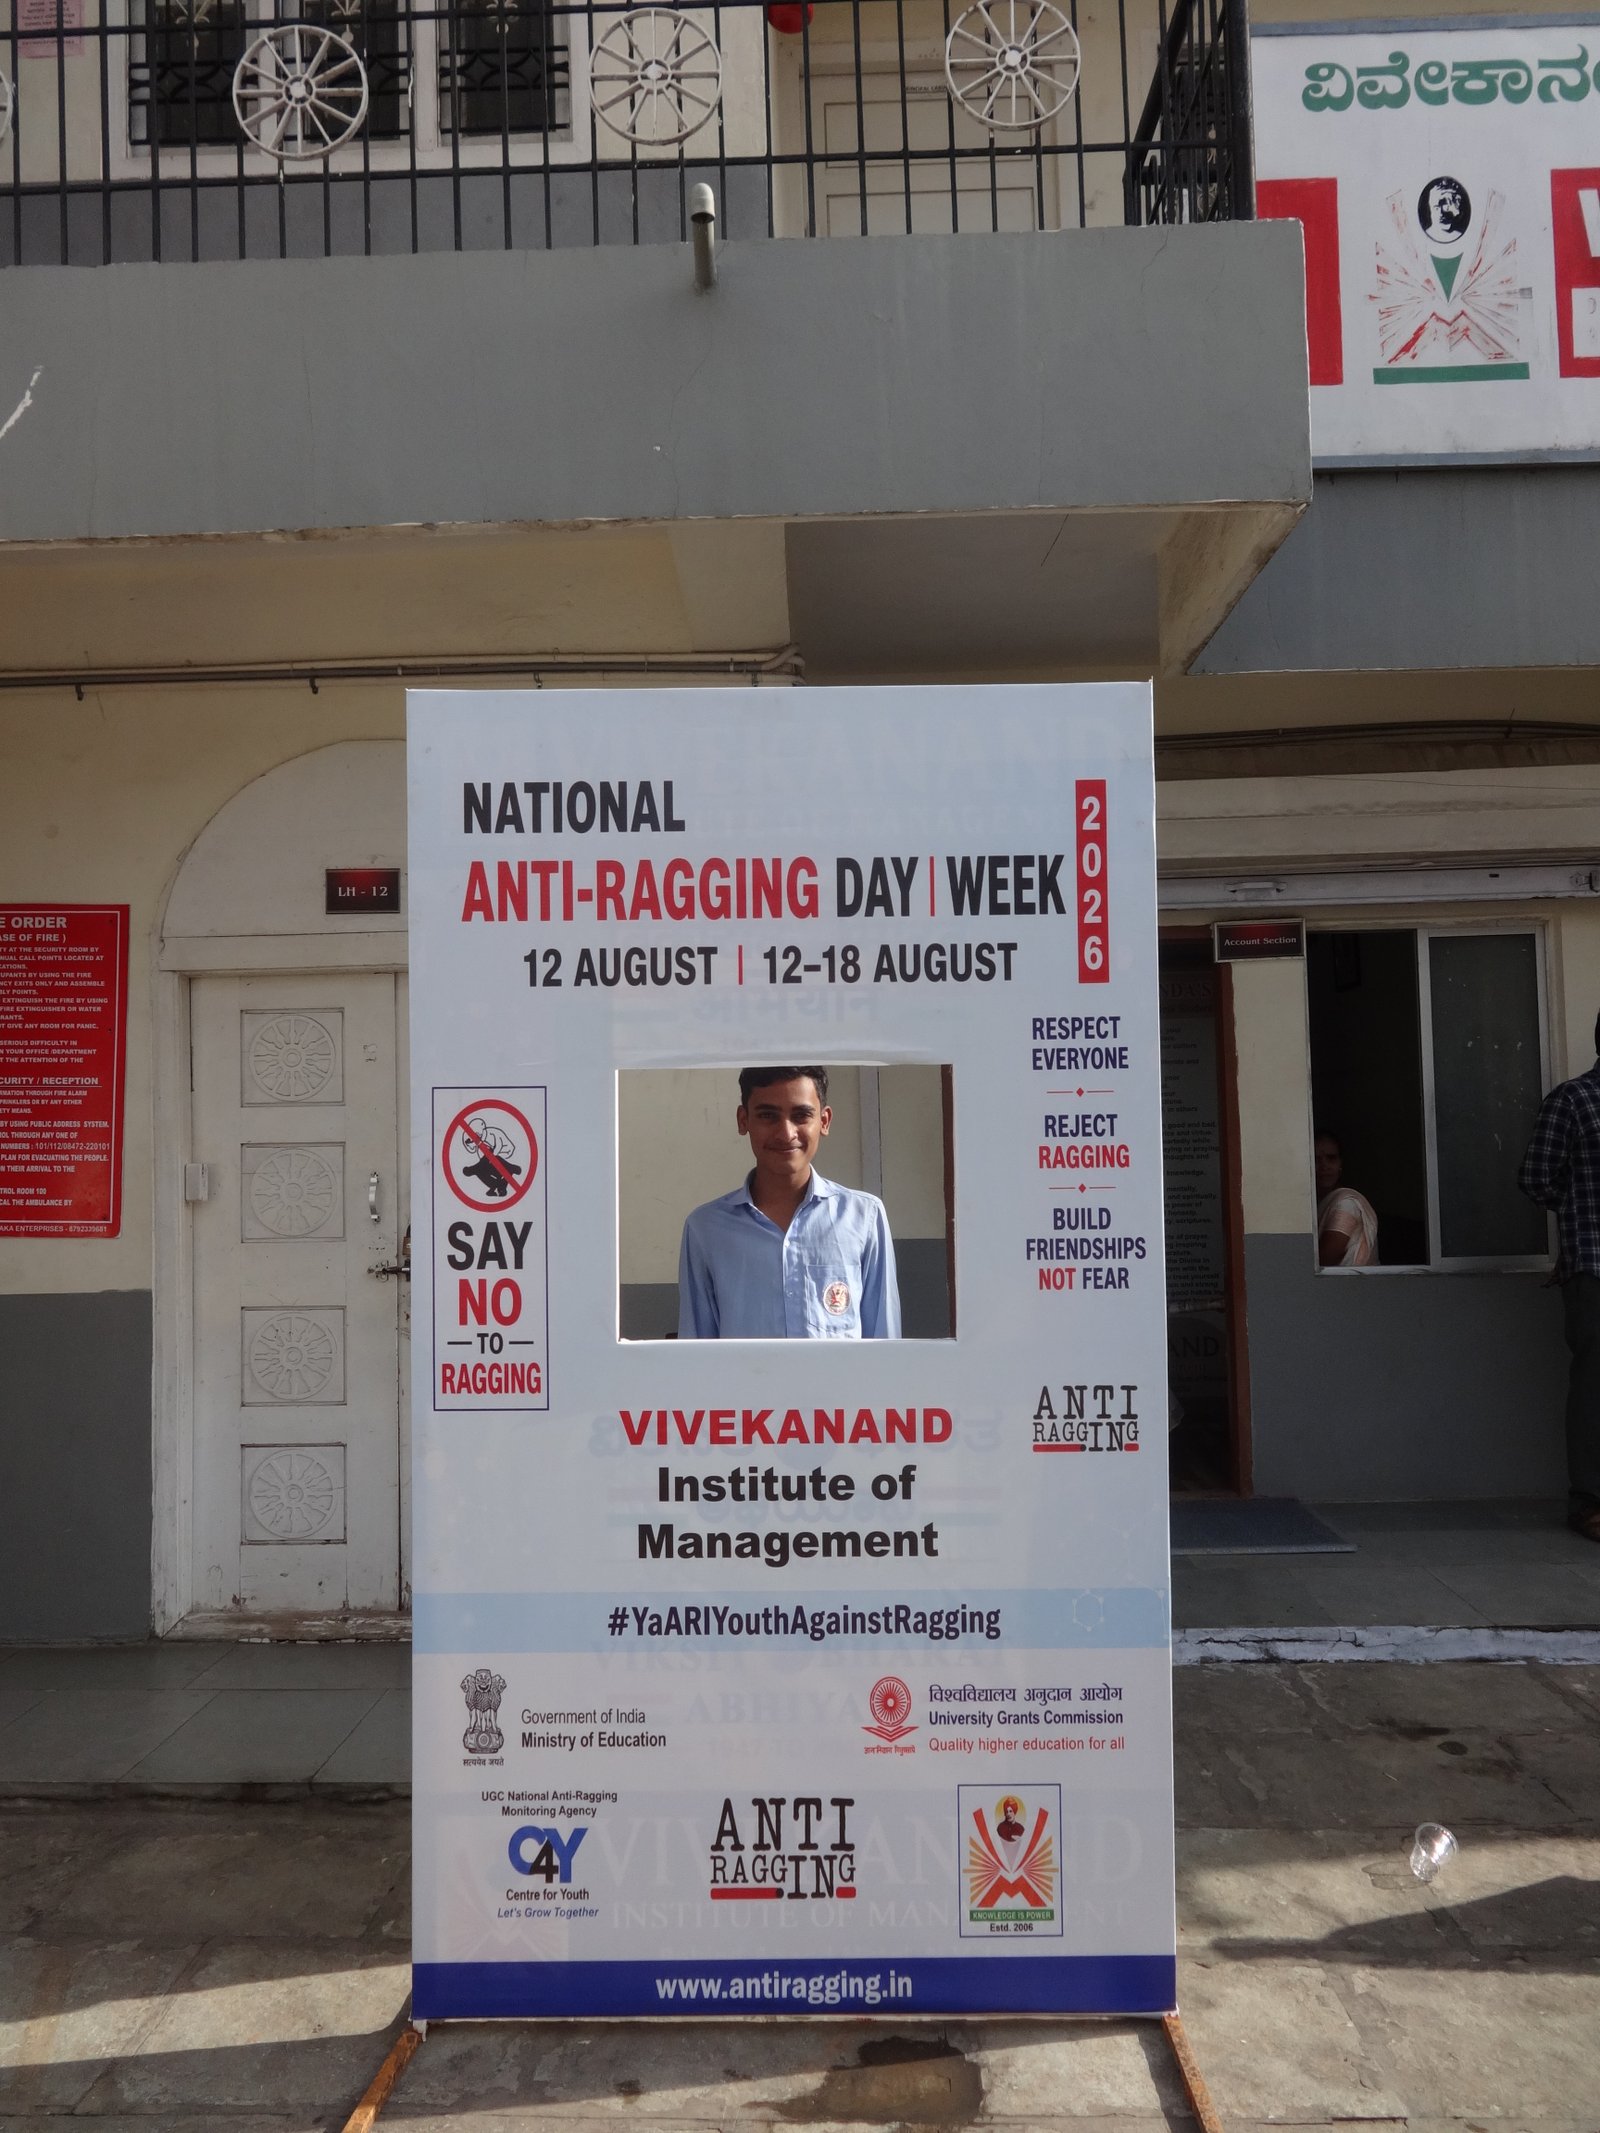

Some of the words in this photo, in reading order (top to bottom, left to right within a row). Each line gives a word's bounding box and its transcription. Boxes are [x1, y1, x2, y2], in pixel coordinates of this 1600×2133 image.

[1301, 43, 1600, 112] ವಿವೇಕಾನ
[463, 781, 685, 834] NATIONAL
[338, 886, 356, 897] LH
[372, 886, 388, 897] 12
[461, 857, 819, 922] ANTI-RAGGING
[836, 857, 916, 918] DAY
[947, 854, 1066, 917] WEEK
[1080, 795, 1104, 973] 2026
[11, 917, 67, 928] ORDER
[19, 934, 32, 942] OF
[36, 934, 59, 942] FIRE
[1224, 938, 1260, 946] Account
[1263, 936, 1298, 944] Section
[523, 948, 561, 988] 12
[574, 945, 718, 987] AUGUST
[873, 941, 1018, 983] AUGUST
[1032, 1016, 1121, 1040] RESPECT
[1032, 1047, 1129, 1070] EVERYONE
[1044, 1114, 1117, 1138] REJECT
[1038, 1145, 1130, 1168] RAGGING
[1052, 1207, 1111, 1230] BUILD
[447, 1221, 533, 1270] SAY
[1026, 1237, 1146, 1261] FRIENDSHIPS
[1038, 1267, 1076, 1290] NOT
[1082, 1266, 1130, 1289] FEAR
[458, 1277, 522, 1326] NO
[476, 1332, 503, 1354] TO
[441, 1363, 541, 1394] RAGGING
[1033, 1385, 1138, 1420] ANTI
[619, 1408, 952, 1445] VIVEKANAND
[1033, 1421, 1138, 1452] RAGGING
[658, 1465, 855, 1502] Institute
[871, 1465, 917, 1500] of
[638, 1522, 939, 1568] Management
[929, 1684, 1016, 1702] विश्वविद्यालय
[1024, 1687, 1072, 1705] अनुदान
[1079, 1683, 1123, 1701] आयोग
[521, 1709, 597, 1725] Government
[601, 1708, 613, 1724] of
[617, 1708, 645, 1724] India
[929, 1711, 993, 1728] University
[997, 1711, 1040, 1725] Grants
[1044, 1710, 1123, 1724] Commission
[521, 1732, 576, 1751] Ministry
[581, 1732, 594, 1748] of
[598, 1731, 666, 1748] Education
[929, 1737, 974, 1753] Quality
[978, 1737, 1019, 1753] higher
[1023, 1736, 1084, 1751] education
[1089, 1736, 1105, 1750] for
[1110, 1737, 1124, 1750] all
[481, 1791, 504, 1802] UGC
[507, 1790, 549, 1801] National
[551, 1790, 618, 1803] Anti-Ragging
[501, 1805, 557, 1818] Monitoring
[559, 1804, 597, 1818] Agency
[710, 1798, 855, 1850] ANTI
[710, 1854, 856, 1900] RAGGING
[506, 1888, 540, 1901] Centre
[542, 1887, 556, 1900] for
[559, 1887, 590, 1900] Youth
[497, 1906, 521, 1918] Let's
[524, 1907, 552, 1918] Grow
[554, 1906, 599, 1919] Together
[973, 1911, 1015, 1920] KNOWLEDGE
[1017, 1911, 1025, 1919] IS
[1026, 1911, 1051, 1920] POWER
[990, 1923, 1011, 1932] Estd.
[1014, 1923, 1034, 1932] 2006
[655, 1970, 913, 2004] www.antiragging.in
